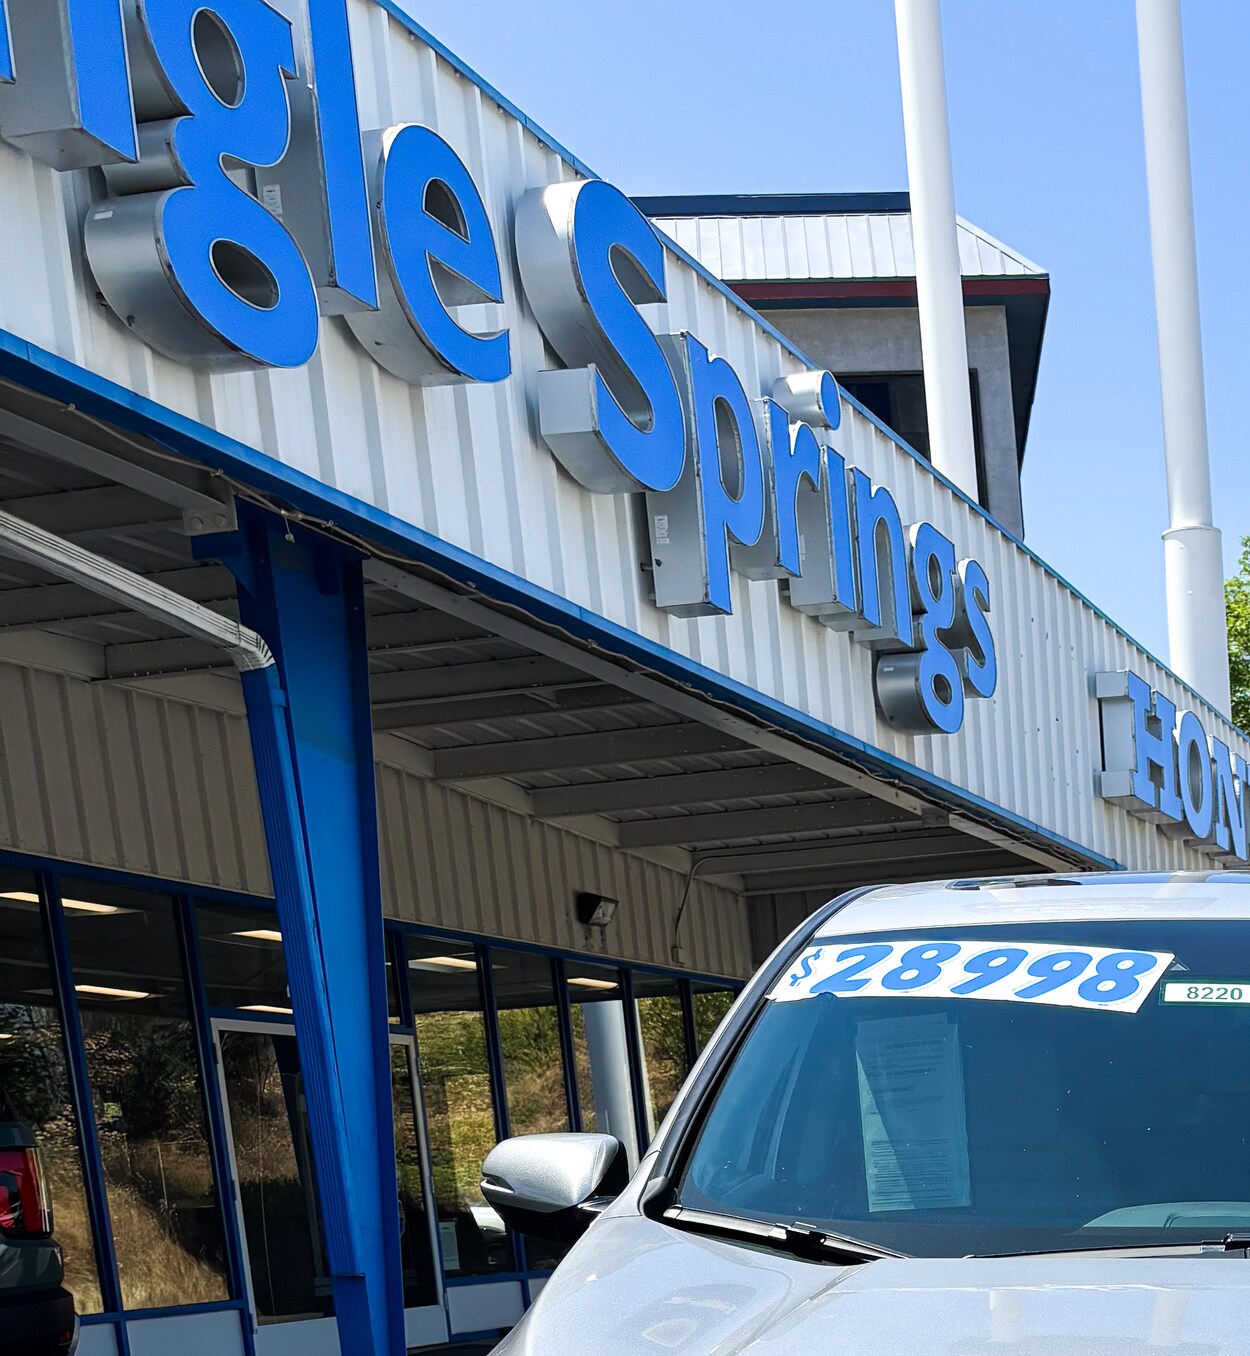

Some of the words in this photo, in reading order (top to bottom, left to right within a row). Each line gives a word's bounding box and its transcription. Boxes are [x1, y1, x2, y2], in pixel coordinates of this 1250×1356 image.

[566, 179, 997, 734] Springs
[790, 942, 1157, 1002] $28998
[1186, 985, 1244, 1002] 8220
